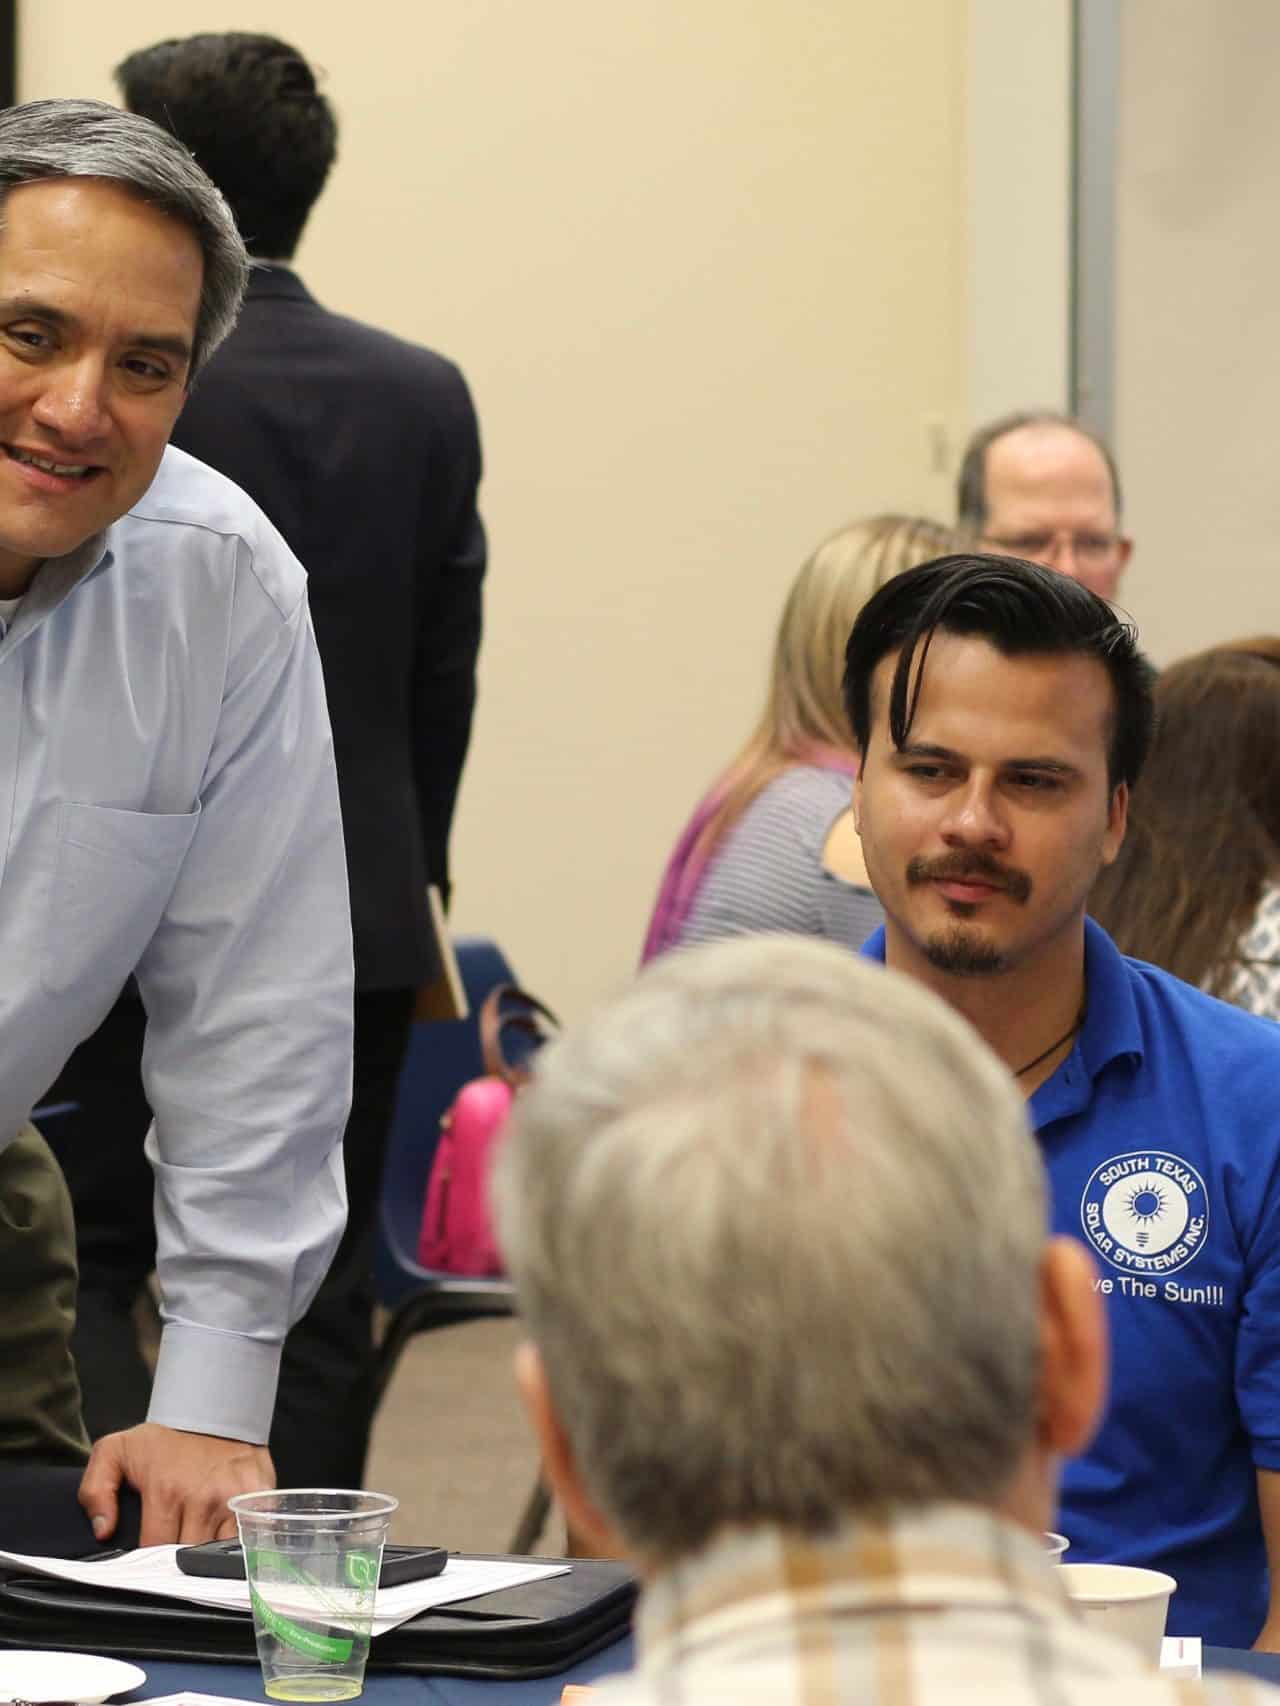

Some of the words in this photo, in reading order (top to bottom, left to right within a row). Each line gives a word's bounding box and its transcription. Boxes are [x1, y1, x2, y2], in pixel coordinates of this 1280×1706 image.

[1099, 1158, 1149, 1186] SOUTH
[1154, 1158, 1198, 1194] TEXAS
[1086, 1202, 1113, 1253] SOLAR
[1113, 1244, 1188, 1271] SYSTEMS
[1185, 1214, 1205, 1246] INC.
[1117, 1276, 1157, 1297] The
[1164, 1281, 1223, 1305] Sun!!!
